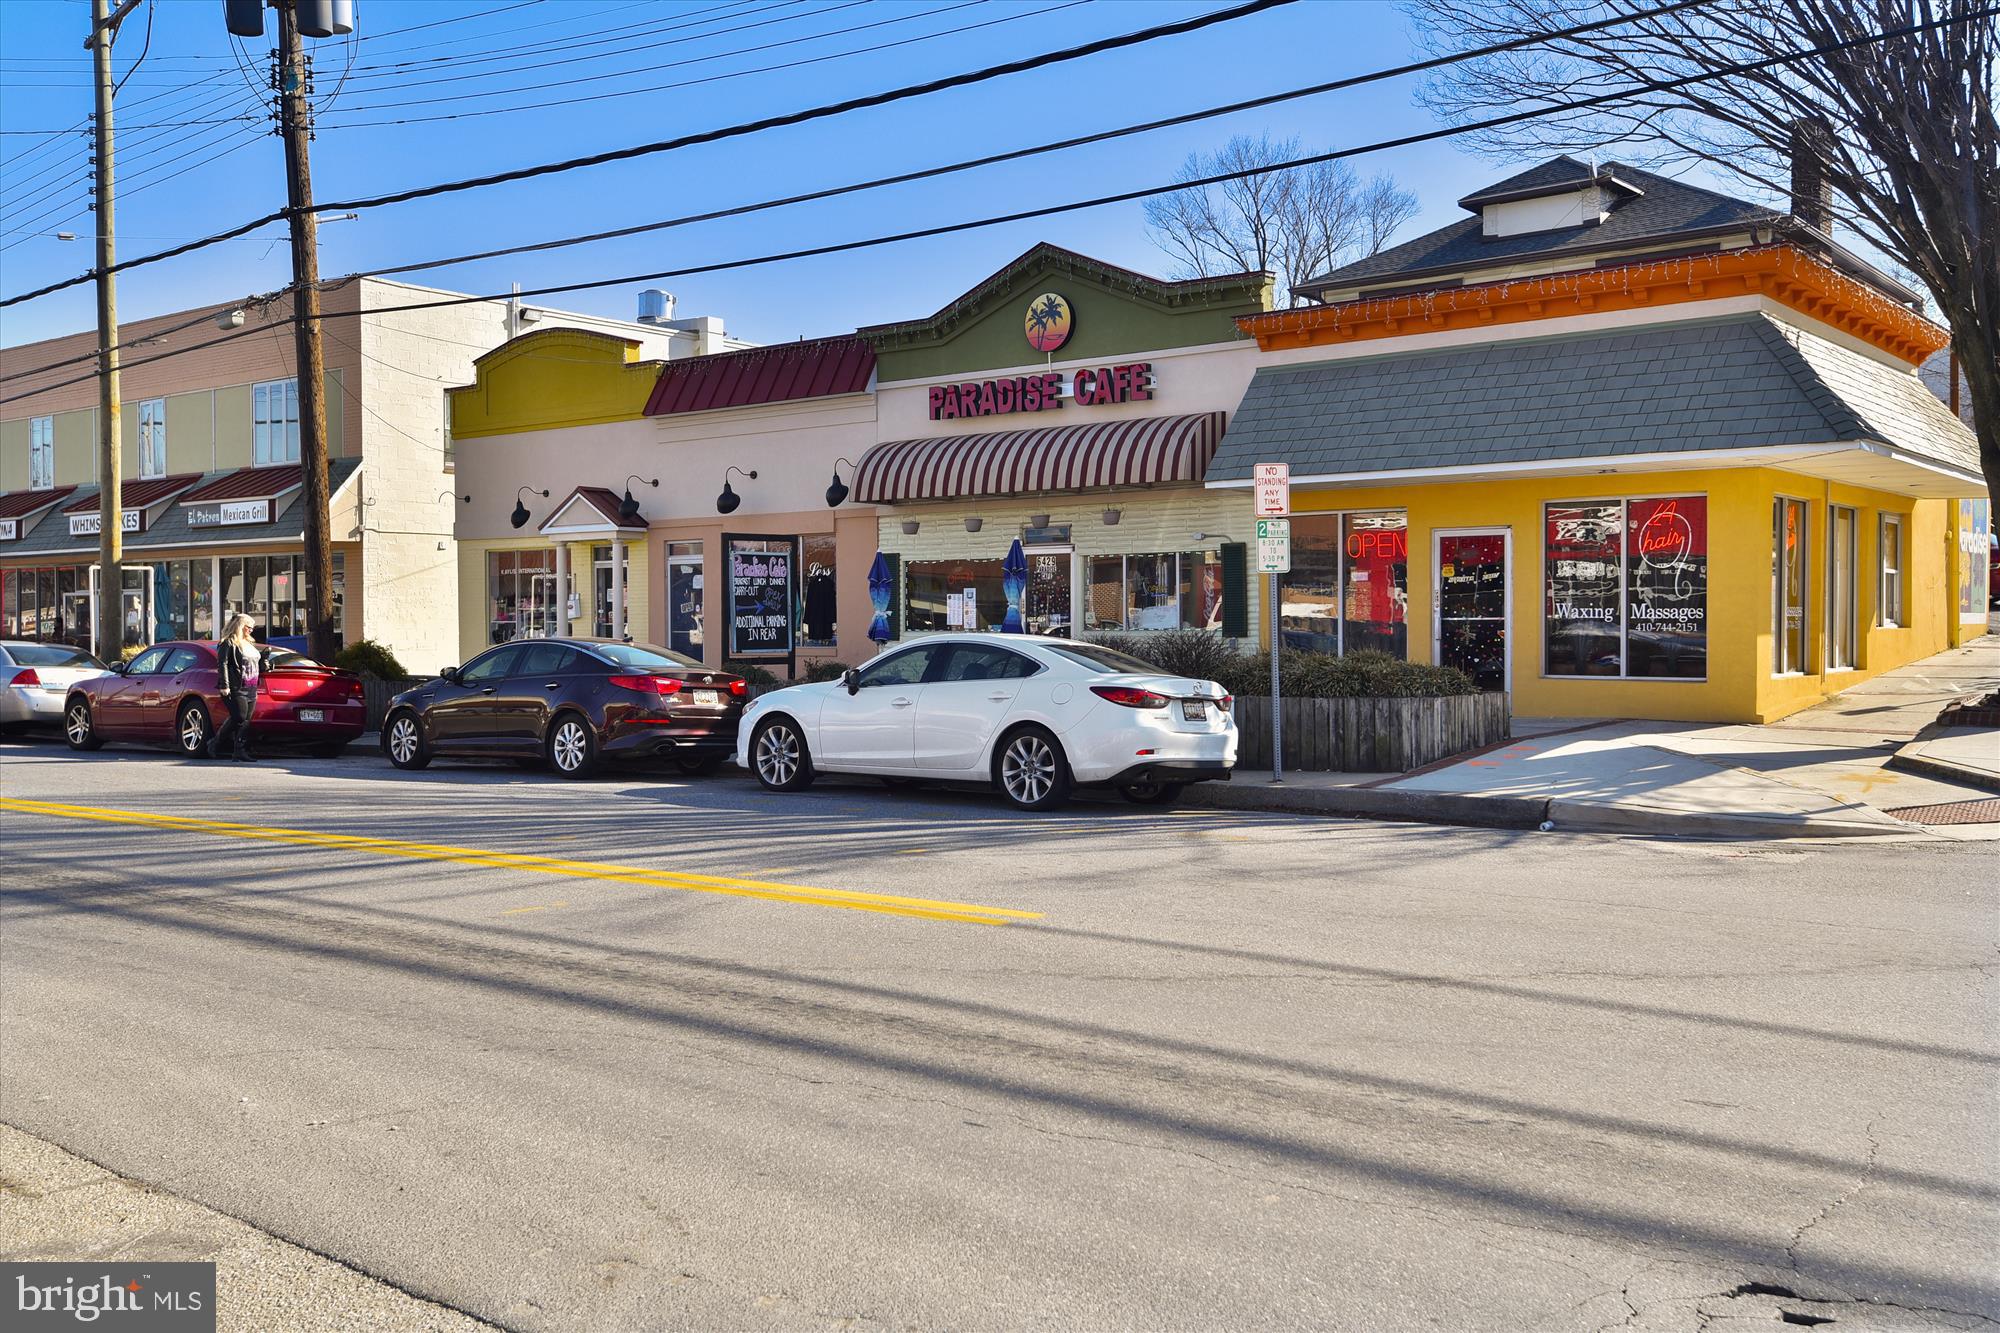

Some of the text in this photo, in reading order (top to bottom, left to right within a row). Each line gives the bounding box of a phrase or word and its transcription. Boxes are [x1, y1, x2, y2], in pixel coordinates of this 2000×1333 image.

[929, 363, 1153, 420] PARADISE CAFE
[1265, 467, 1277, 475] NO
[1257, 478, 1286, 486] STANDING
[188, 509, 196, 525] El
[223, 508, 250, 521] Mexican
[252, 505, 267, 519] Grill
[1648, 501, 1677, 526] LA
[1259, 523, 1266, 536] 2
[1347, 531, 1408, 558] OPEN
[1643, 528, 1685, 552] hair
[734, 554, 769, 577] Paradise
[753, 577, 767, 586] LUNCH
[770, 577, 786, 586] DINNER
[1556, 603, 1704, 622] Waxing Massages
[736, 615, 787, 627] ADDITIONAL PARKING
[1636, 623, 1698, 632] 410-744-2151
[748, 627, 777, 641] IN REAR
